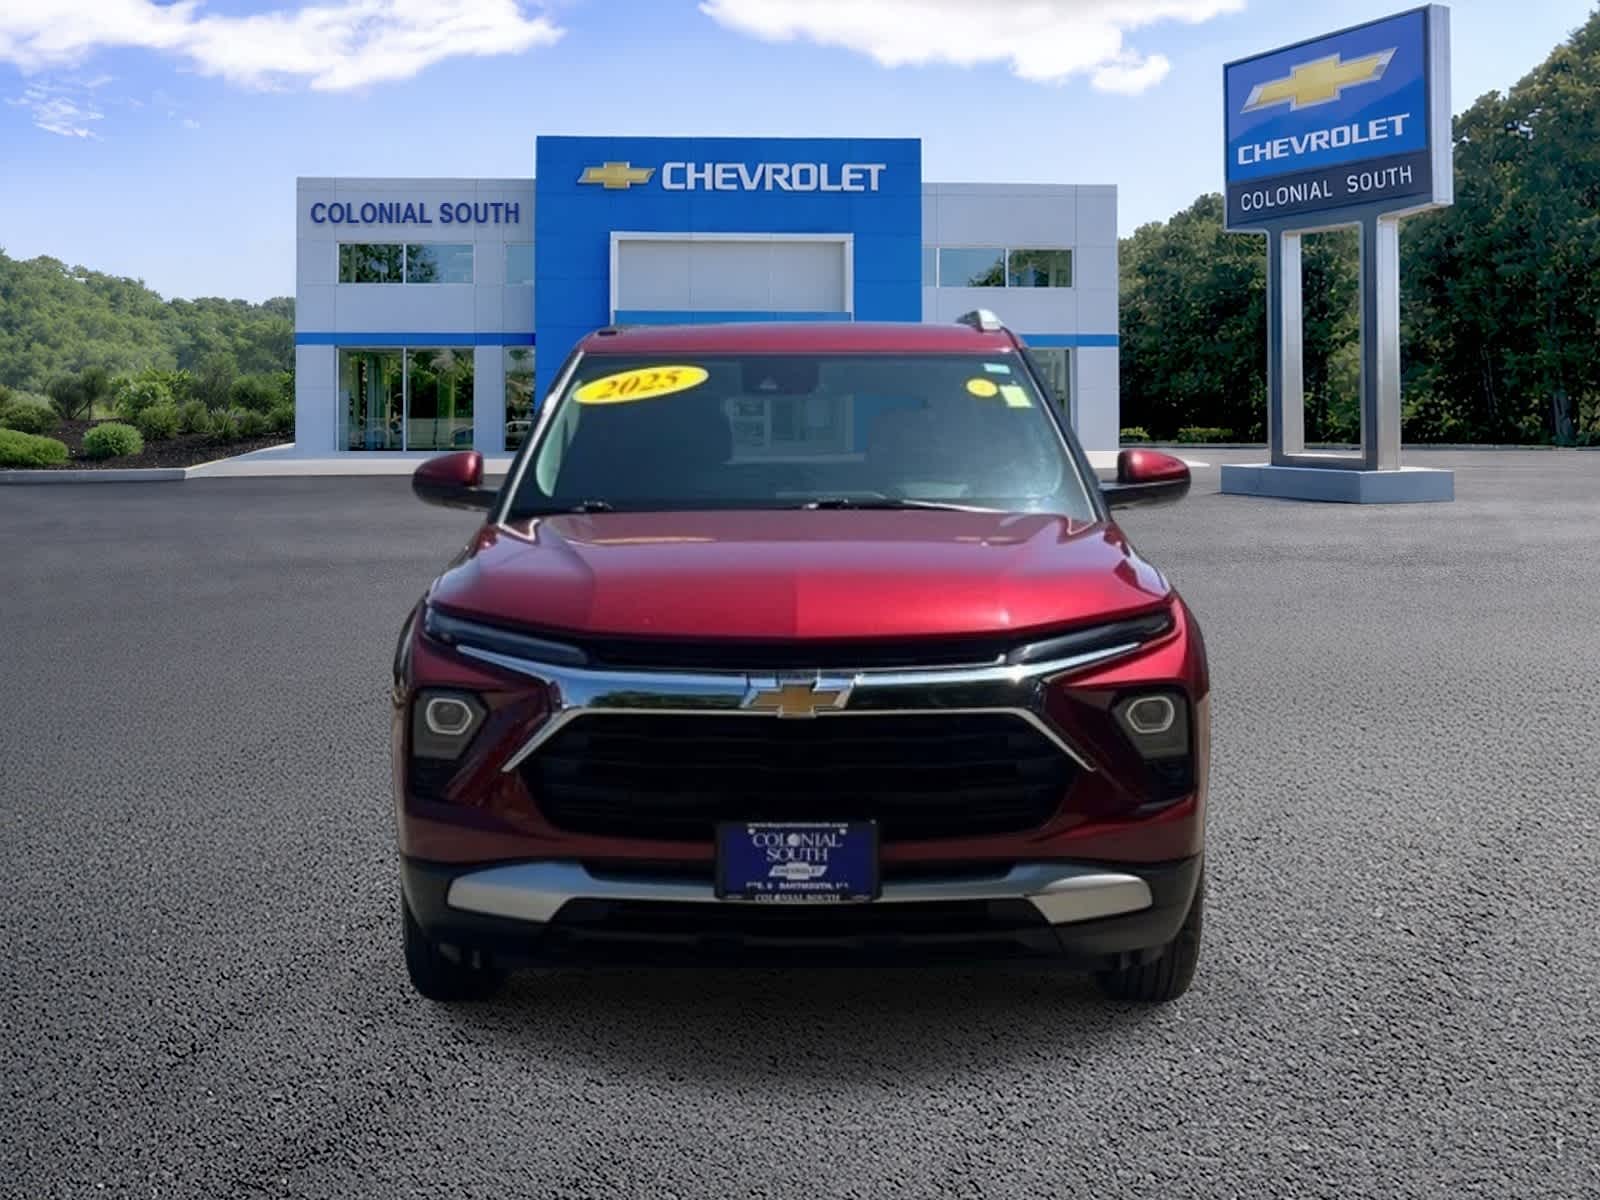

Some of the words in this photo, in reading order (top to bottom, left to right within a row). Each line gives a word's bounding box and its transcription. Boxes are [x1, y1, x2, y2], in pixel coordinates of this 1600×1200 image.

[1237, 113, 1410, 165] CHEVROLET
[661, 161, 887, 192] CHEVROLET
[1240, 179, 1333, 211] COLONIAL
[1346, 165, 1413, 193] SOUTH
[310, 202, 433, 224] COLONIAL
[439, 202, 520, 224] SOUTH
[596, 370, 682, 399] 2025
[752, 832, 843, 848] COLONIAL
[766, 848, 828, 861] SOUTH
